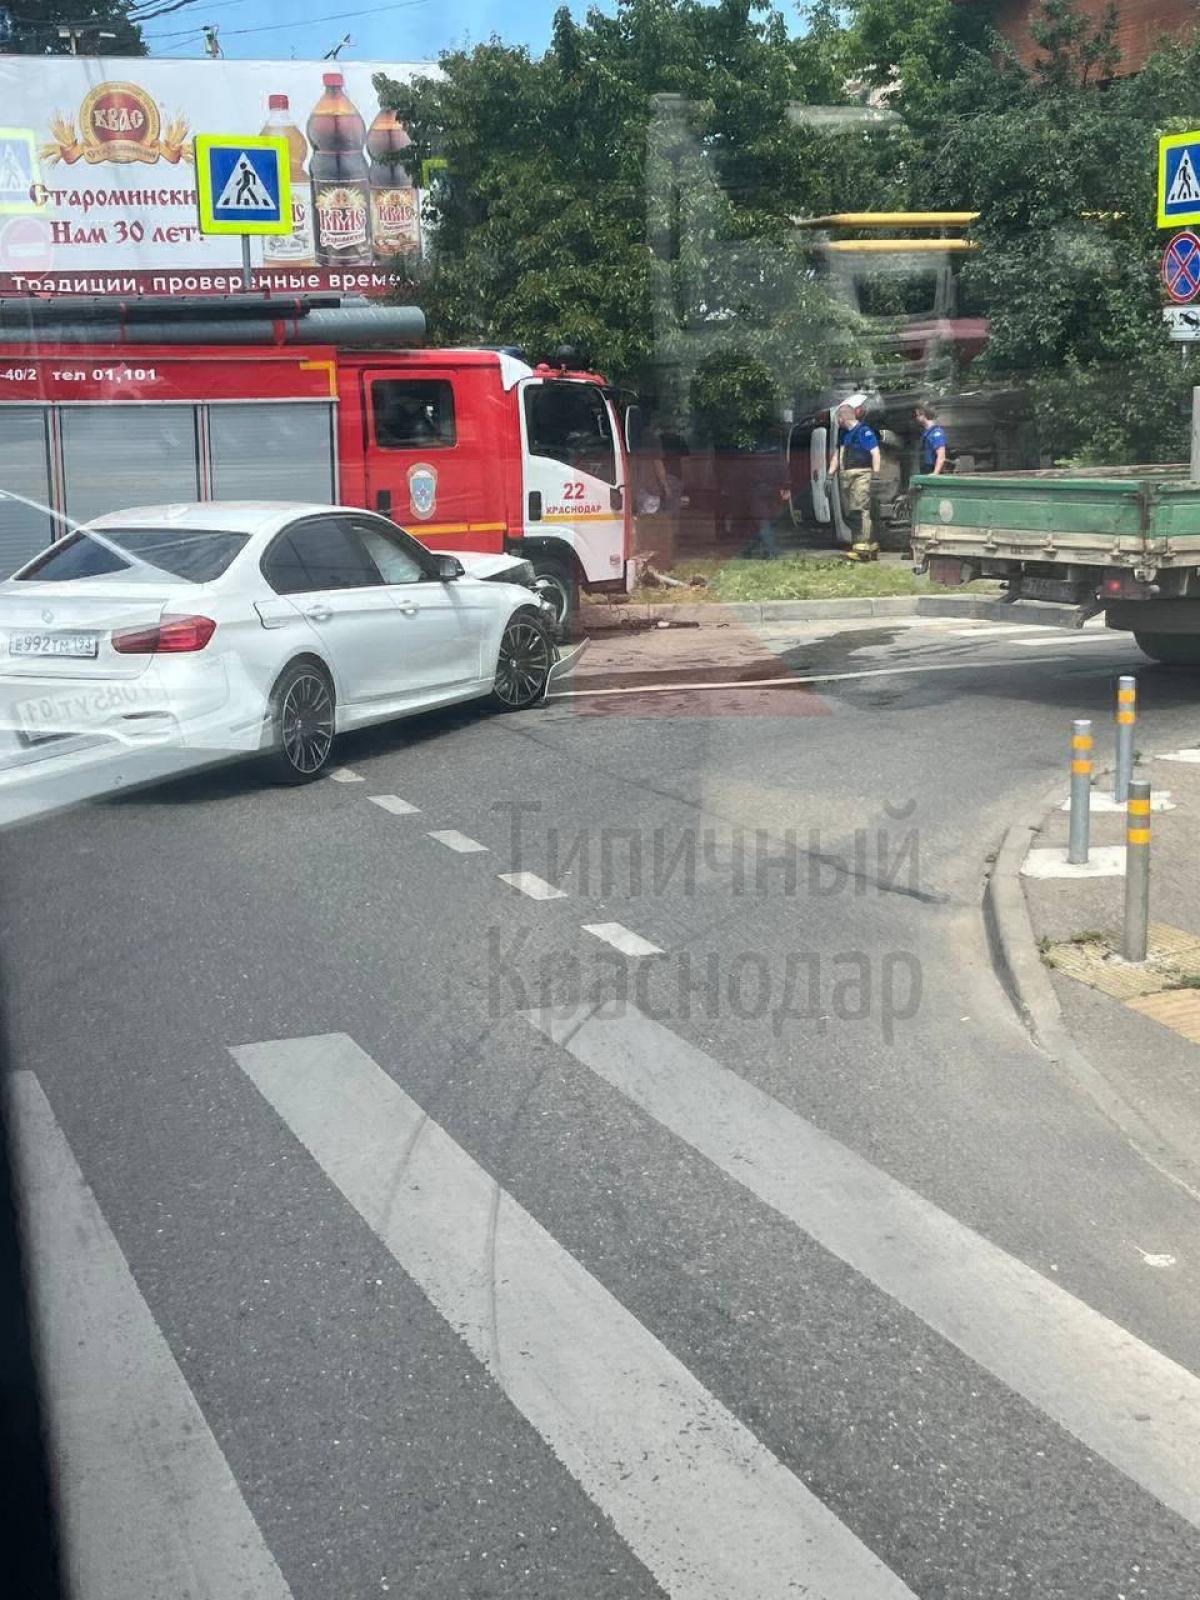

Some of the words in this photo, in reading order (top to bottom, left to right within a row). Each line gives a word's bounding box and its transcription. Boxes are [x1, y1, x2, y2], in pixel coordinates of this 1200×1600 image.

[29, 183, 199, 213] Старомински
[50, 220, 107, 244] Нам
[113, 219, 145, 244] 30
[11, 276, 144, 294] Традиции,
[52, 371, 86, 381] тел
[92, 368, 156, 384] 01,101
[563, 482, 585, 500] 22
[545, 505, 602, 515] КРАСНОДАР
